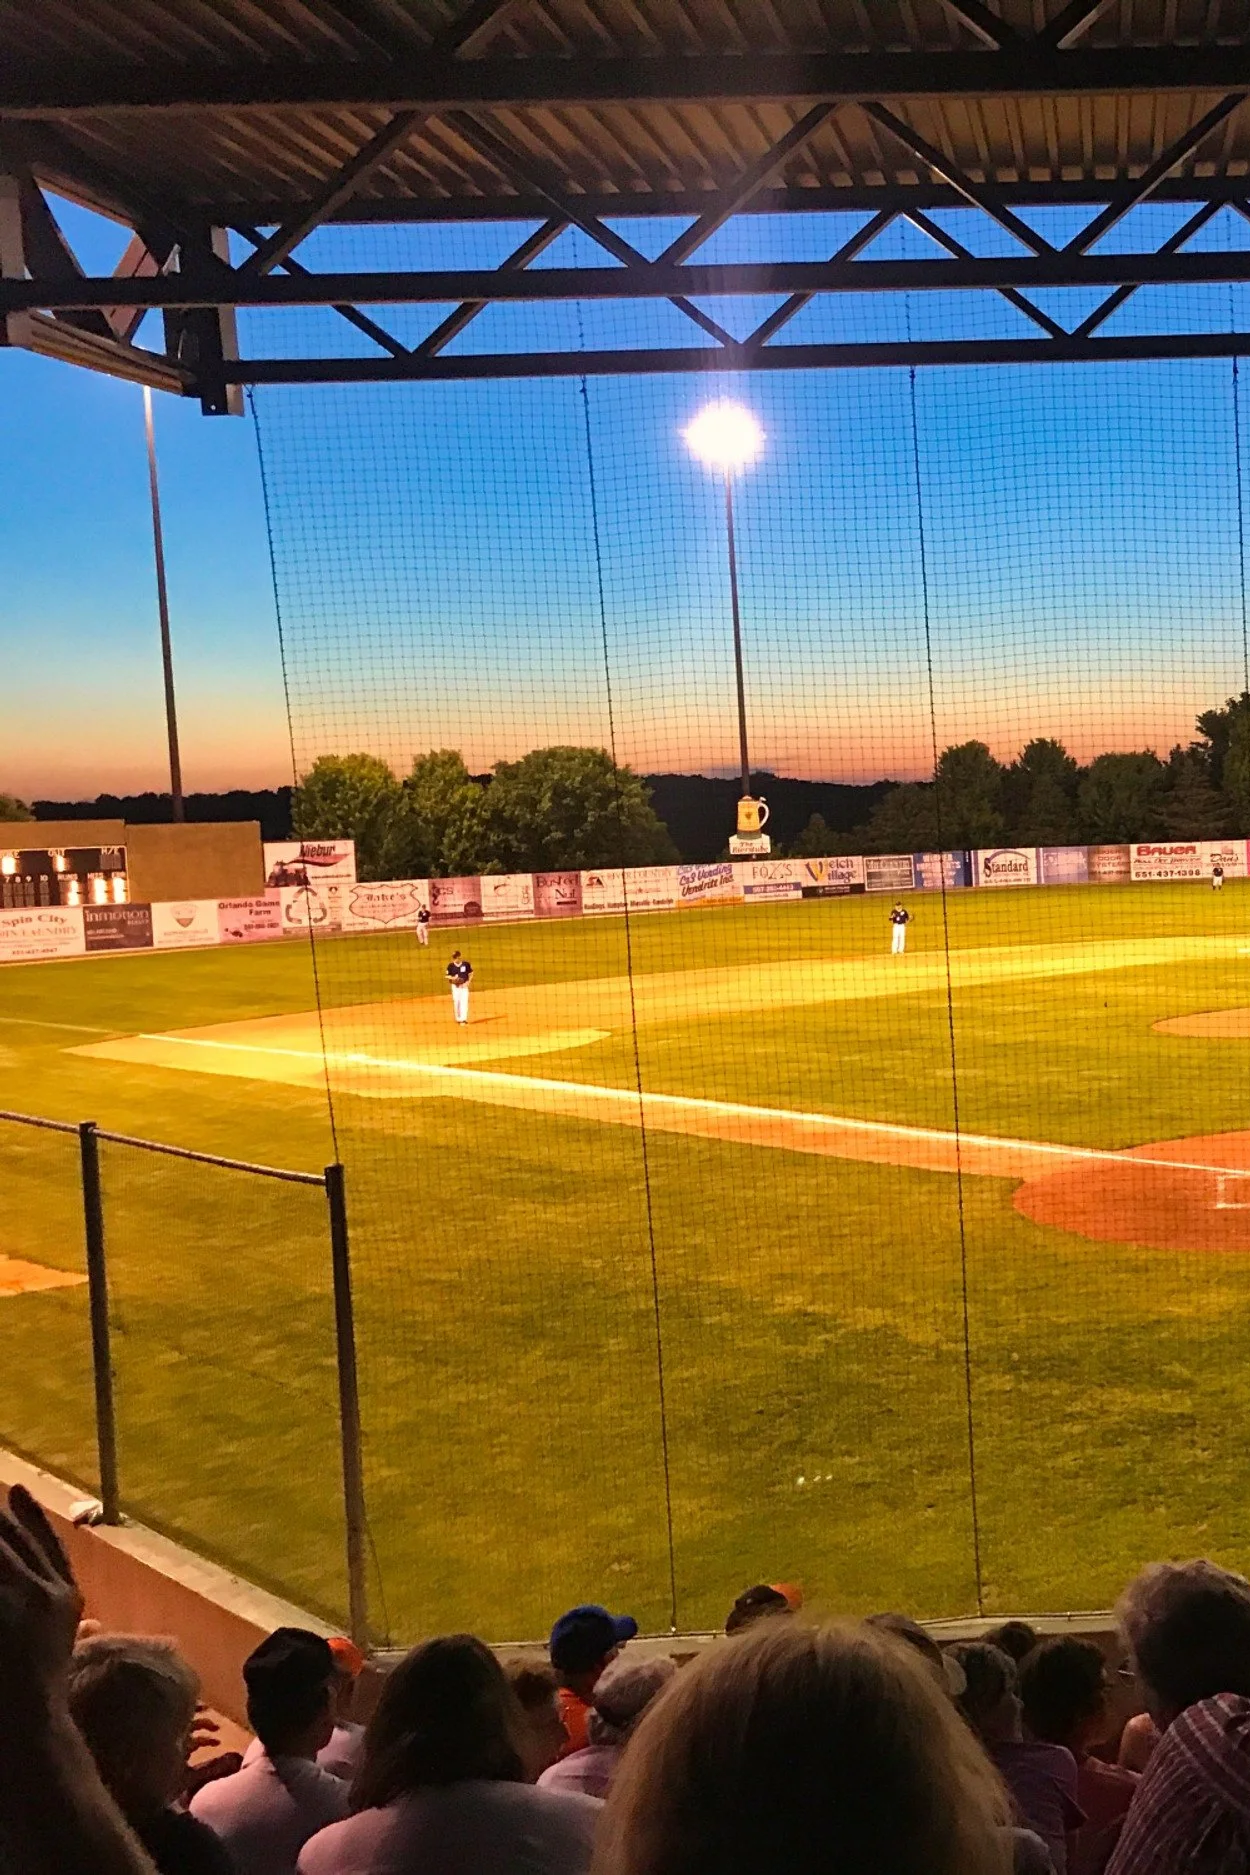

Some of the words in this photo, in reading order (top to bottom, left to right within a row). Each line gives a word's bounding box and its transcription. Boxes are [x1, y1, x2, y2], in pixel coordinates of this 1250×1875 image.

[1137, 845, 1197, 856] BAUER
[983, 858, 1029, 878] Standard
[37, 913, 68, 924] City
